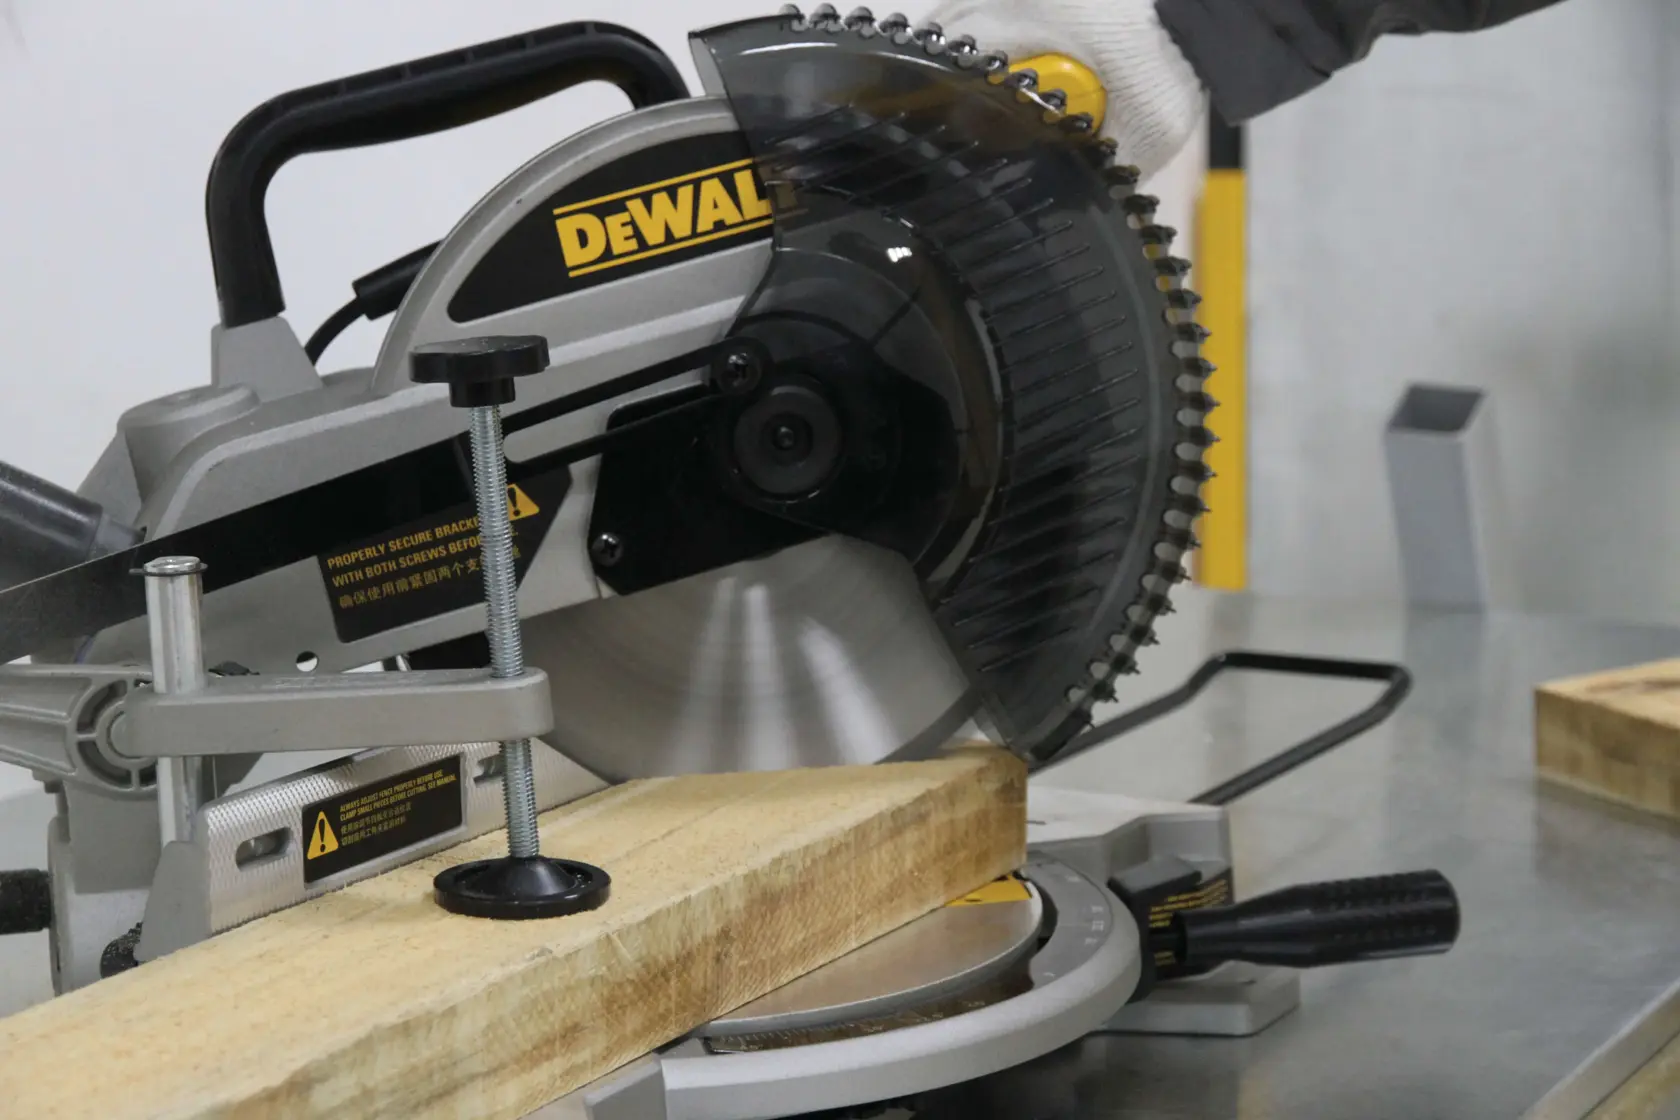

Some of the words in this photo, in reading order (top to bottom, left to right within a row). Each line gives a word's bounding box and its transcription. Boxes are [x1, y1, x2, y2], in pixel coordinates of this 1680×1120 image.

[327, 543, 386, 569] PROPERLY
[388, 529, 432, 552] SECURE
[435, 516, 480, 537] BRACKE
[332, 569, 364, 588] WITH
[365, 560, 397, 578] BOTH
[398, 545, 447, 568] SCREWS
